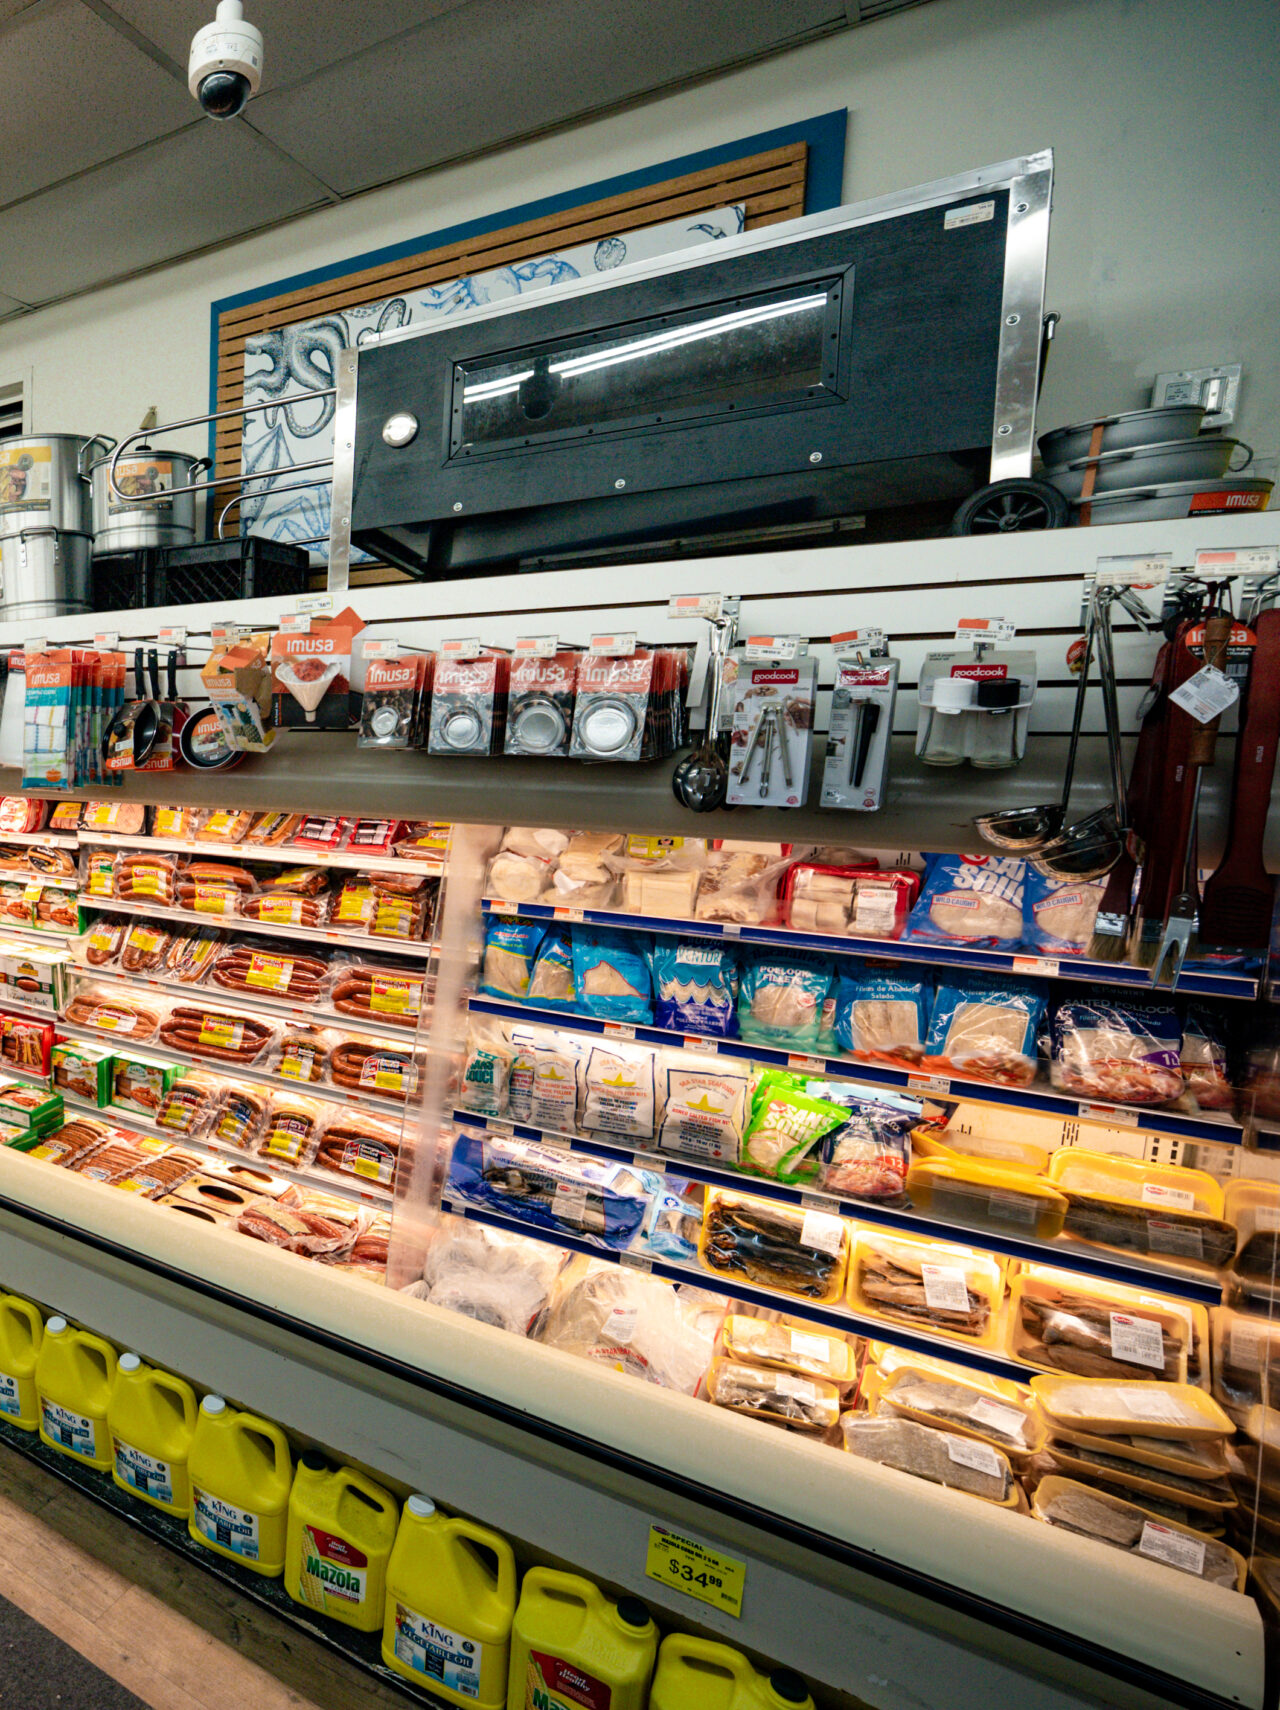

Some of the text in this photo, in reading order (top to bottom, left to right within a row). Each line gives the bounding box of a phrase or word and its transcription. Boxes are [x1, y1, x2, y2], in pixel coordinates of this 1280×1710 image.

[1226, 495, 1260, 507] imusa
[1192, 629, 1248, 643] isa
[287, 639, 334, 653] imusa
[11, 657, 25, 665] imus
[31, 673, 61, 684] imusa
[370, 669, 410, 683] imusa
[439, 670, 487, 684] imusa
[517, 666, 566, 682] imusa
[586, 667, 641, 683] imusa
[753, 671, 797, 683] goodcook
[954, 667, 1005, 679] goodcook
[198, 721, 221, 734] imus
[935, 896, 977, 908] WILD CAUGHT
[1035, 895, 1078, 910] WILD CAUGHT
[1065, 999, 1111, 1008] SALTED
[1114, 1001, 1176, 1015] POLLOCK
[56, 1408, 76, 1424] KING
[129, 1450, 152, 1468] KING
[212, 1501, 237, 1520] KING
[671, 1534, 704, 1552] SPECIAL
[306, 1555, 361, 1593] Mazola
[421, 1622, 453, 1647] KING
[402, 1626, 454, 1660] VEGETABLE
[454, 1656, 472, 1668] OIL
